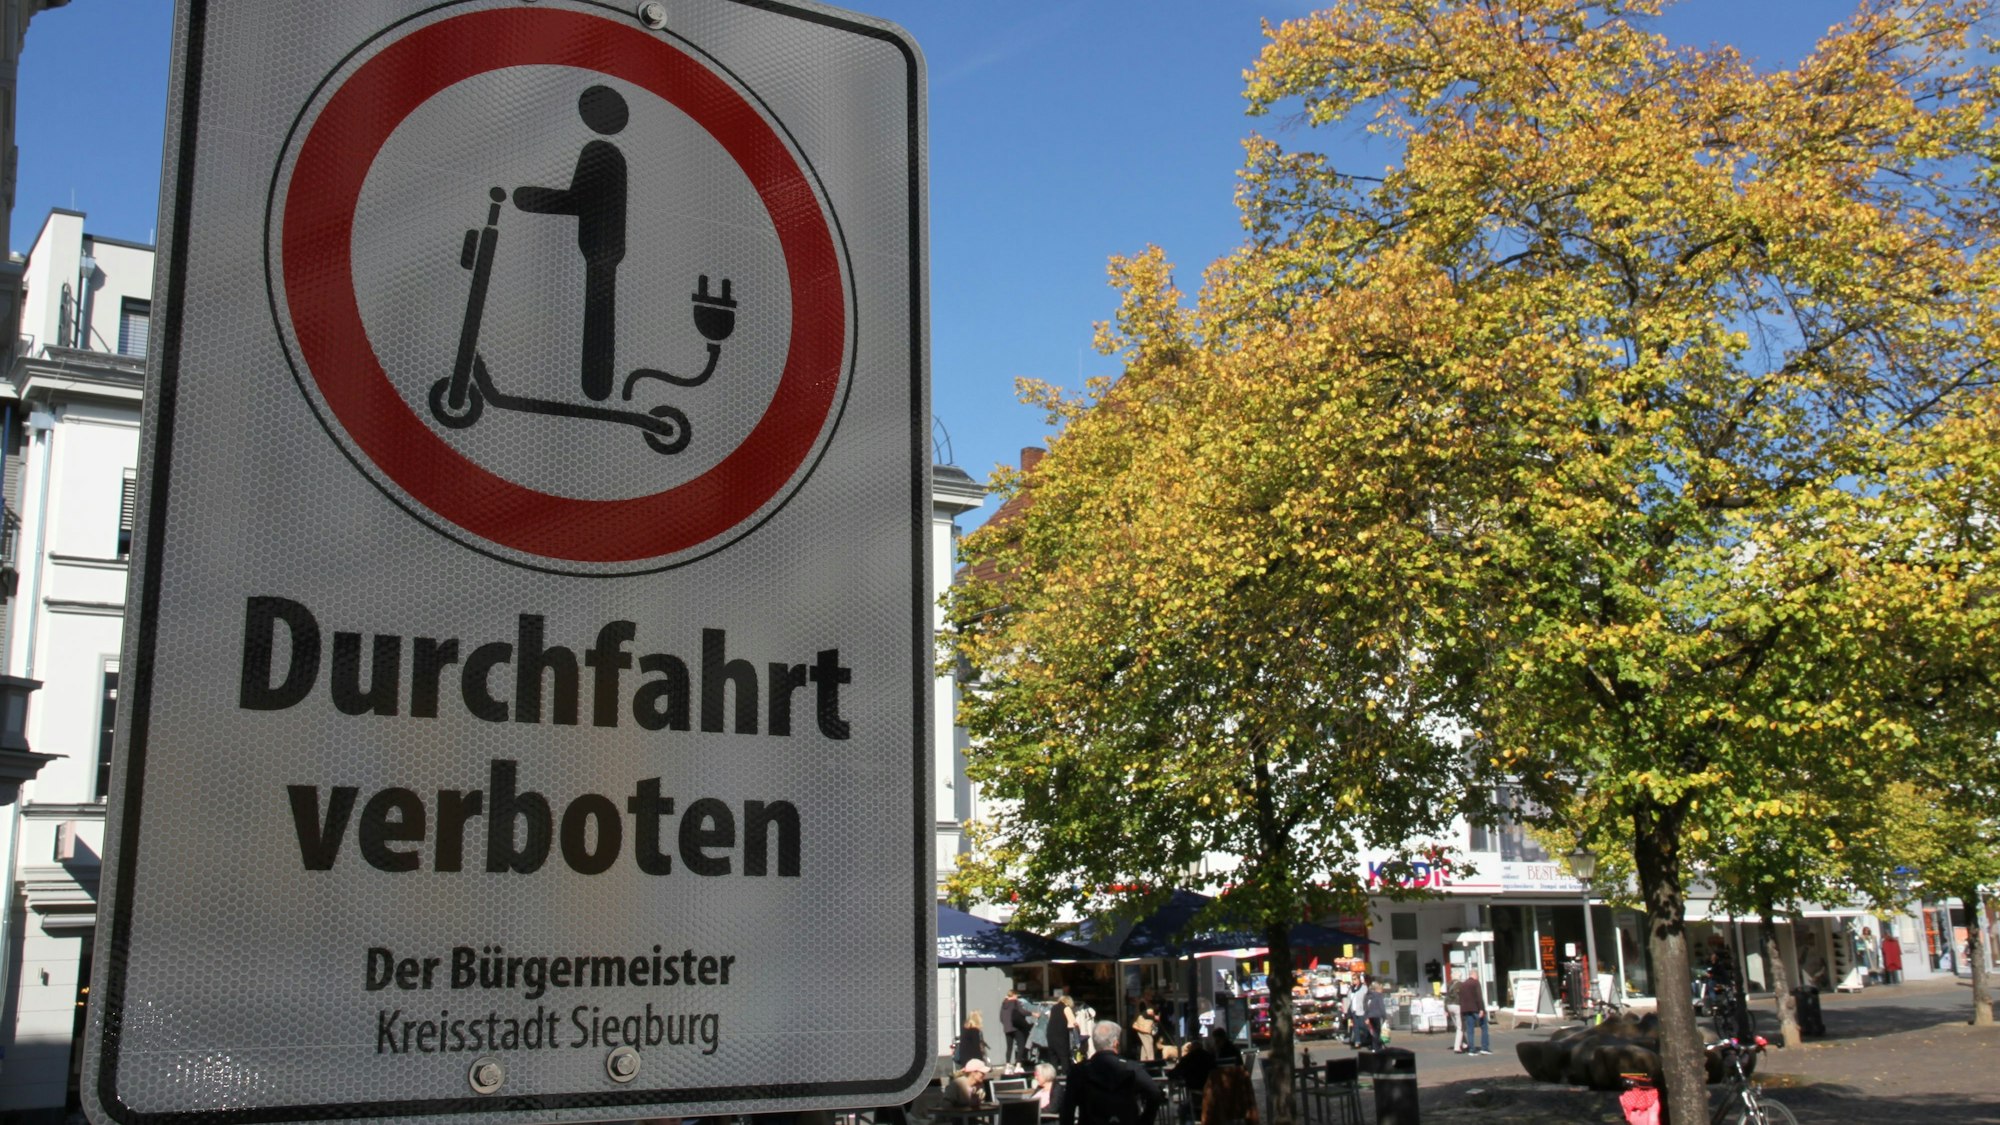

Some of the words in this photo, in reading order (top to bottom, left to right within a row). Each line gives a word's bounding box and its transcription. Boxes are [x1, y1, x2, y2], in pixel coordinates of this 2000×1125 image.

[240, 596, 851, 740] Durchfahrt
[287, 759, 801, 877] verboten
[366, 947, 440, 991] Der
[451, 945, 735, 1000] Bürgermeister
[377, 1006, 560, 1054] Kreisstadt
[571, 1003, 719, 1055] Siegburg
